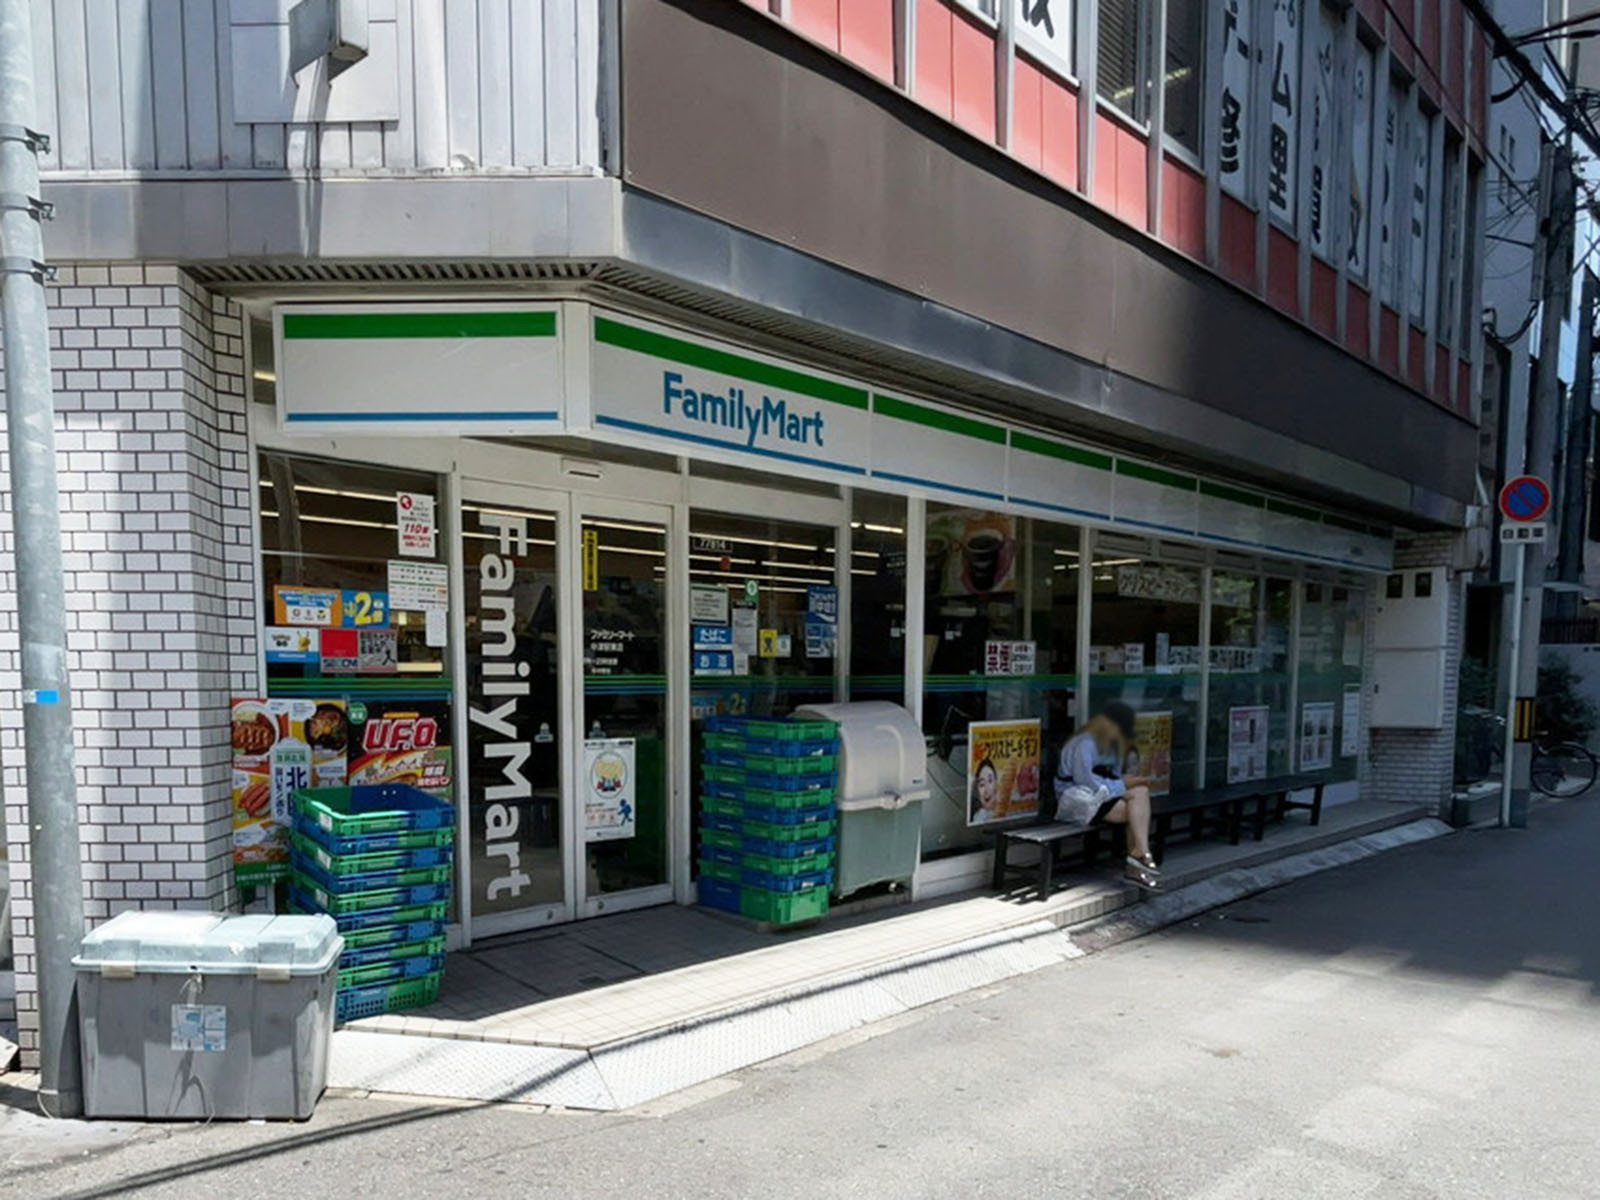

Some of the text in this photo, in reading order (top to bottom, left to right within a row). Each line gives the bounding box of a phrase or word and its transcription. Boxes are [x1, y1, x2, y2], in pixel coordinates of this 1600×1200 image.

[663, 371, 824, 447] FamilyMart
[354, 592, 372, 625] 2
[590, 630, 635, 641] ファミリーマート
[700, 629, 728, 643] たばこ
[469, 511, 532, 901] FamilyMart
